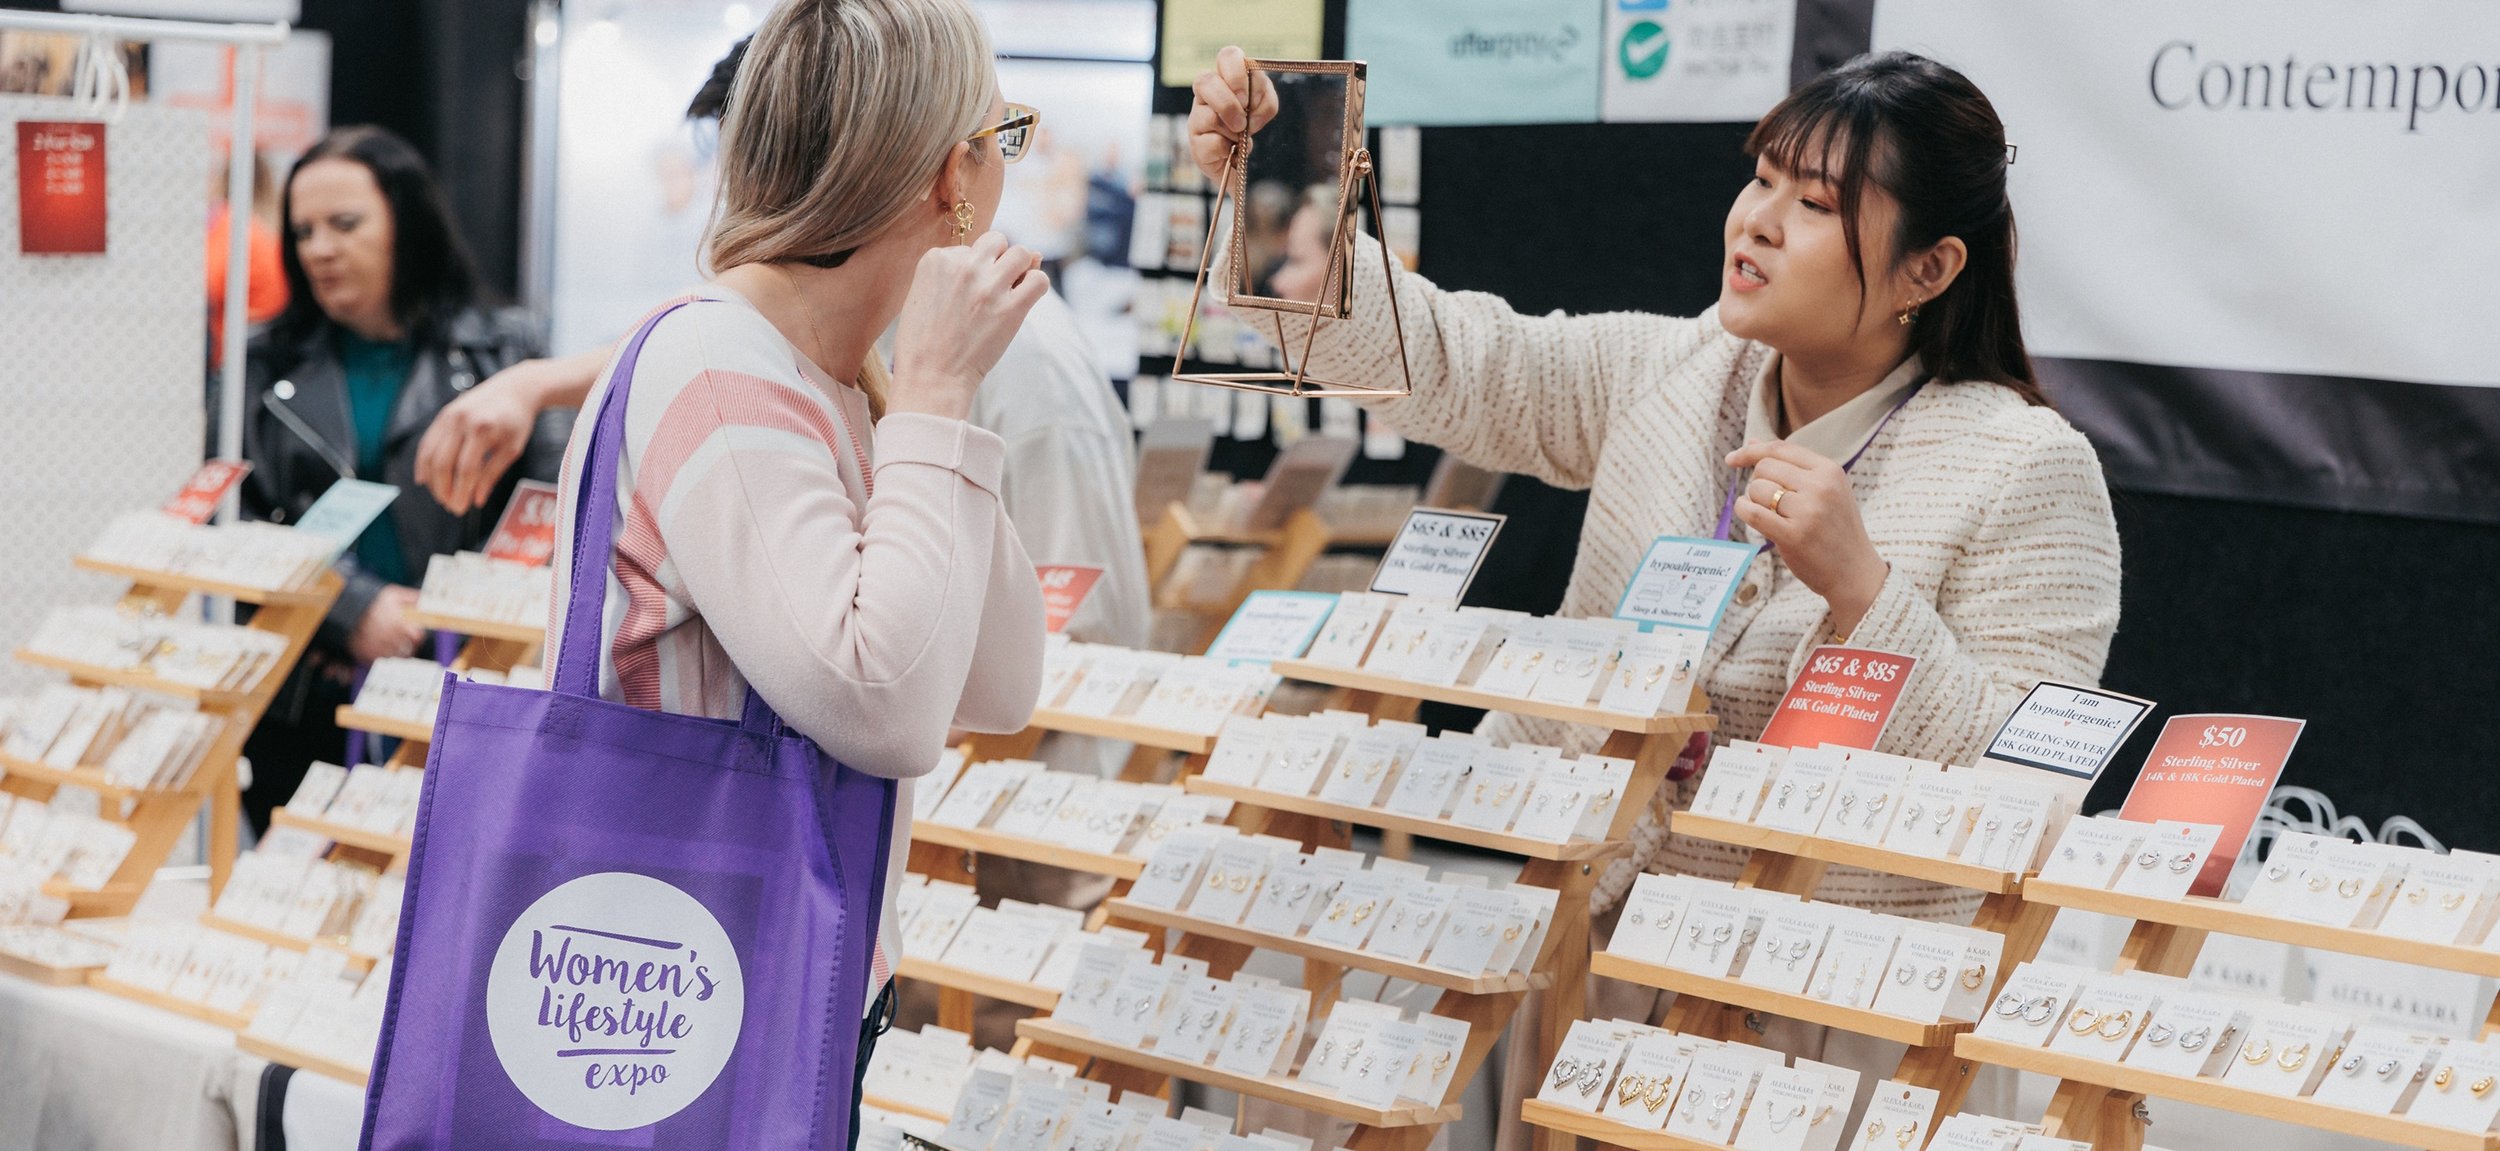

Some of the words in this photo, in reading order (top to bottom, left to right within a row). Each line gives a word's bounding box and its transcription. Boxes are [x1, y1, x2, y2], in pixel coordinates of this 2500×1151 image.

[1686, 546, 1693, 556] I
[1695, 550, 1710, 558] am
[1650, 559, 1731, 577] hypoallergenic!
[1632, 605, 1650, 615] Sleep
[1660, 608, 1685, 618] Shower
[1687, 611, 1702, 619] Safe
[1811, 655, 1844, 675] $65
[1843, 658, 1861, 677] &
[1863, 659, 1900, 682] $85
[1802, 680, 1845, 699] Sterling
[1846, 685, 1881, 702] Silver
[2071, 693, 2080, 703] I
[2080, 697, 2100, 708] am
[1788, 697, 1813, 711] 18K
[1811, 699, 1839, 715] Gold
[1840, 704, 1879, 723] Plated
[2029, 701, 2121, 729] hypoallergenic!
[2005, 726, 2061, 746] STERLING
[2064, 738, 2107, 756] SILVER
[2199, 724, 2247, 748] $50
[1997, 739, 2019, 751] 18K
[2017, 742, 2051, 757] GOLD
[2051, 748, 2098, 768] PLATED
[2161, 755, 2216, 770] Sterling
[2217, 756, 2261, 771] Silver
[2144, 772, 2164, 782] 14K
[2167, 772, 2177, 782] &
[2178, 772, 2200, 782] 18K
[2202, 773, 2228, 784] Gold
[2229, 775, 2265, 788] Plated
[1973, 948, 1991, 957] KARA
[529, 930, 720, 1001] Women's
[537, 985, 693, 1048] Lifestyle
[585, 1062, 671, 1096] expo
[1770, 1080, 1791, 1091] ALEXA
[1797, 1085, 1814, 1095] KARA
[1828, 1083, 1846, 1092] KARA
